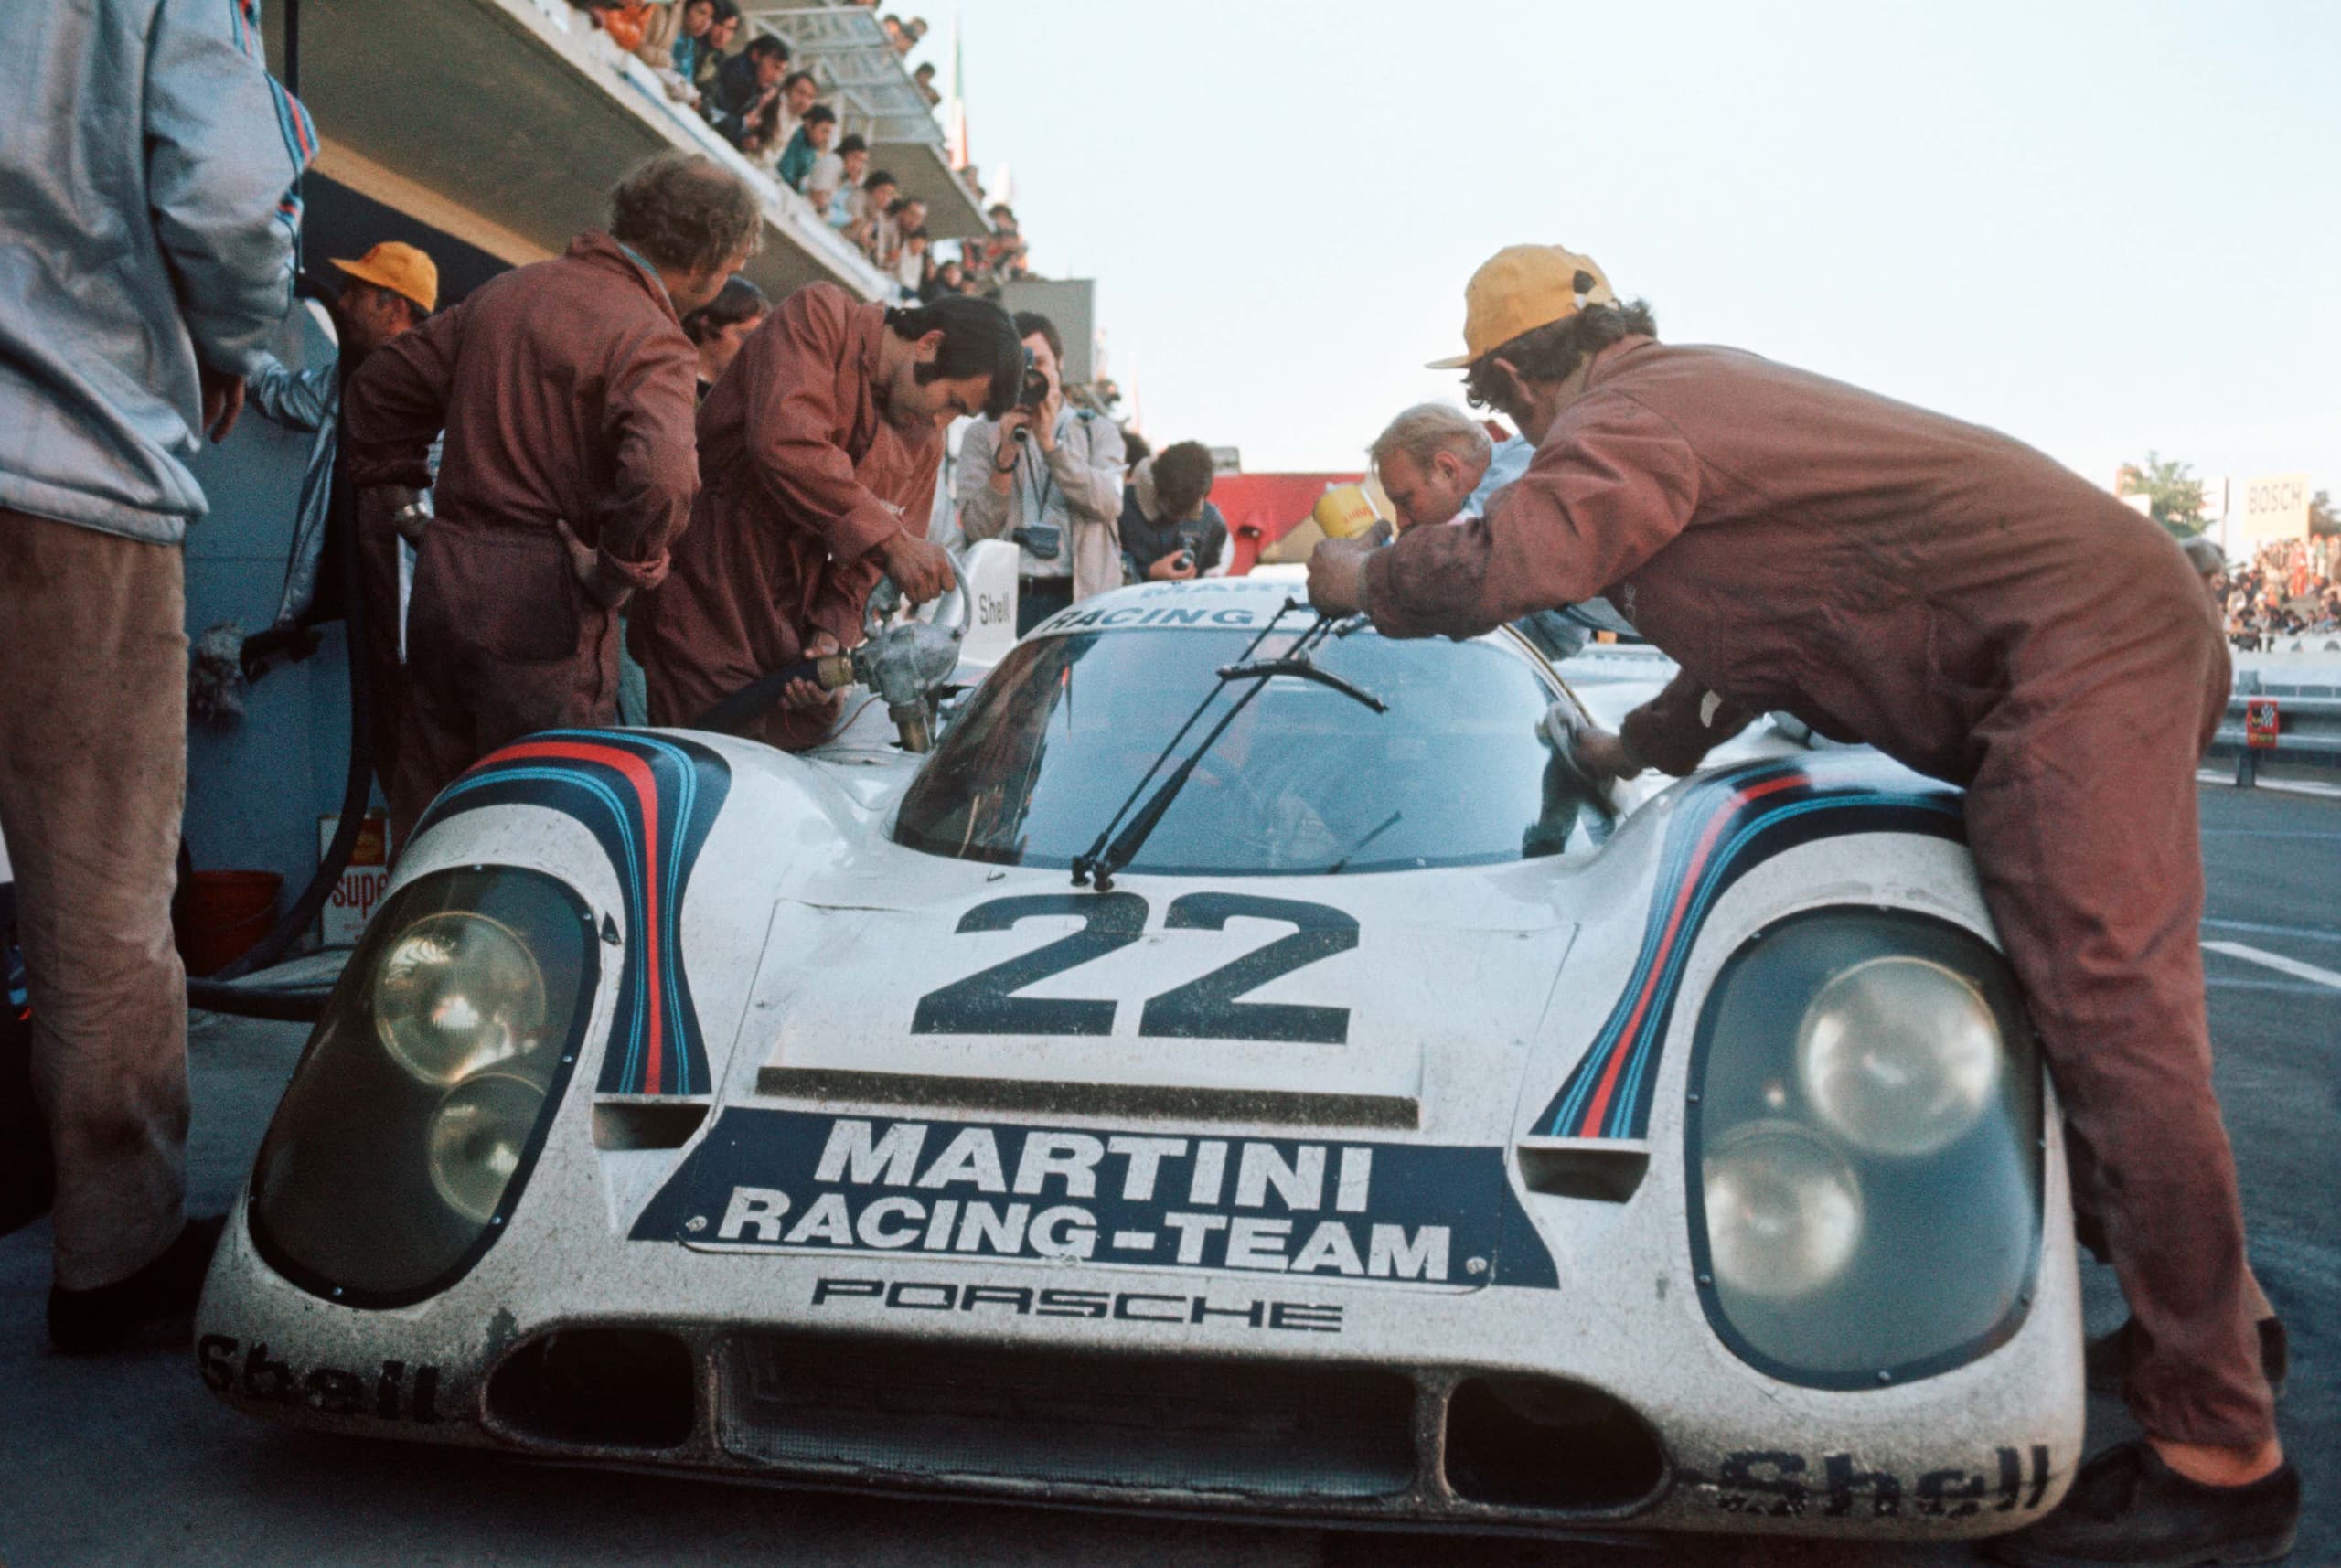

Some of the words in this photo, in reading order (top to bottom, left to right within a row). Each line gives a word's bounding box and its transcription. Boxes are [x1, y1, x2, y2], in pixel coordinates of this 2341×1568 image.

[2249, 482, 2302, 516] BOSCH
[979, 592, 1010, 625] Shell
[1042, 607, 1254, 633] RACING
[910, 891, 1360, 1045] 22
[814, 1119, 1372, 1212] MARTINI
[717, 1186, 1450, 1280] RACING-TEAM
[811, 1277, 1343, 1333] PORSCHE
[1720, 1445, 2049, 1516] Shell
